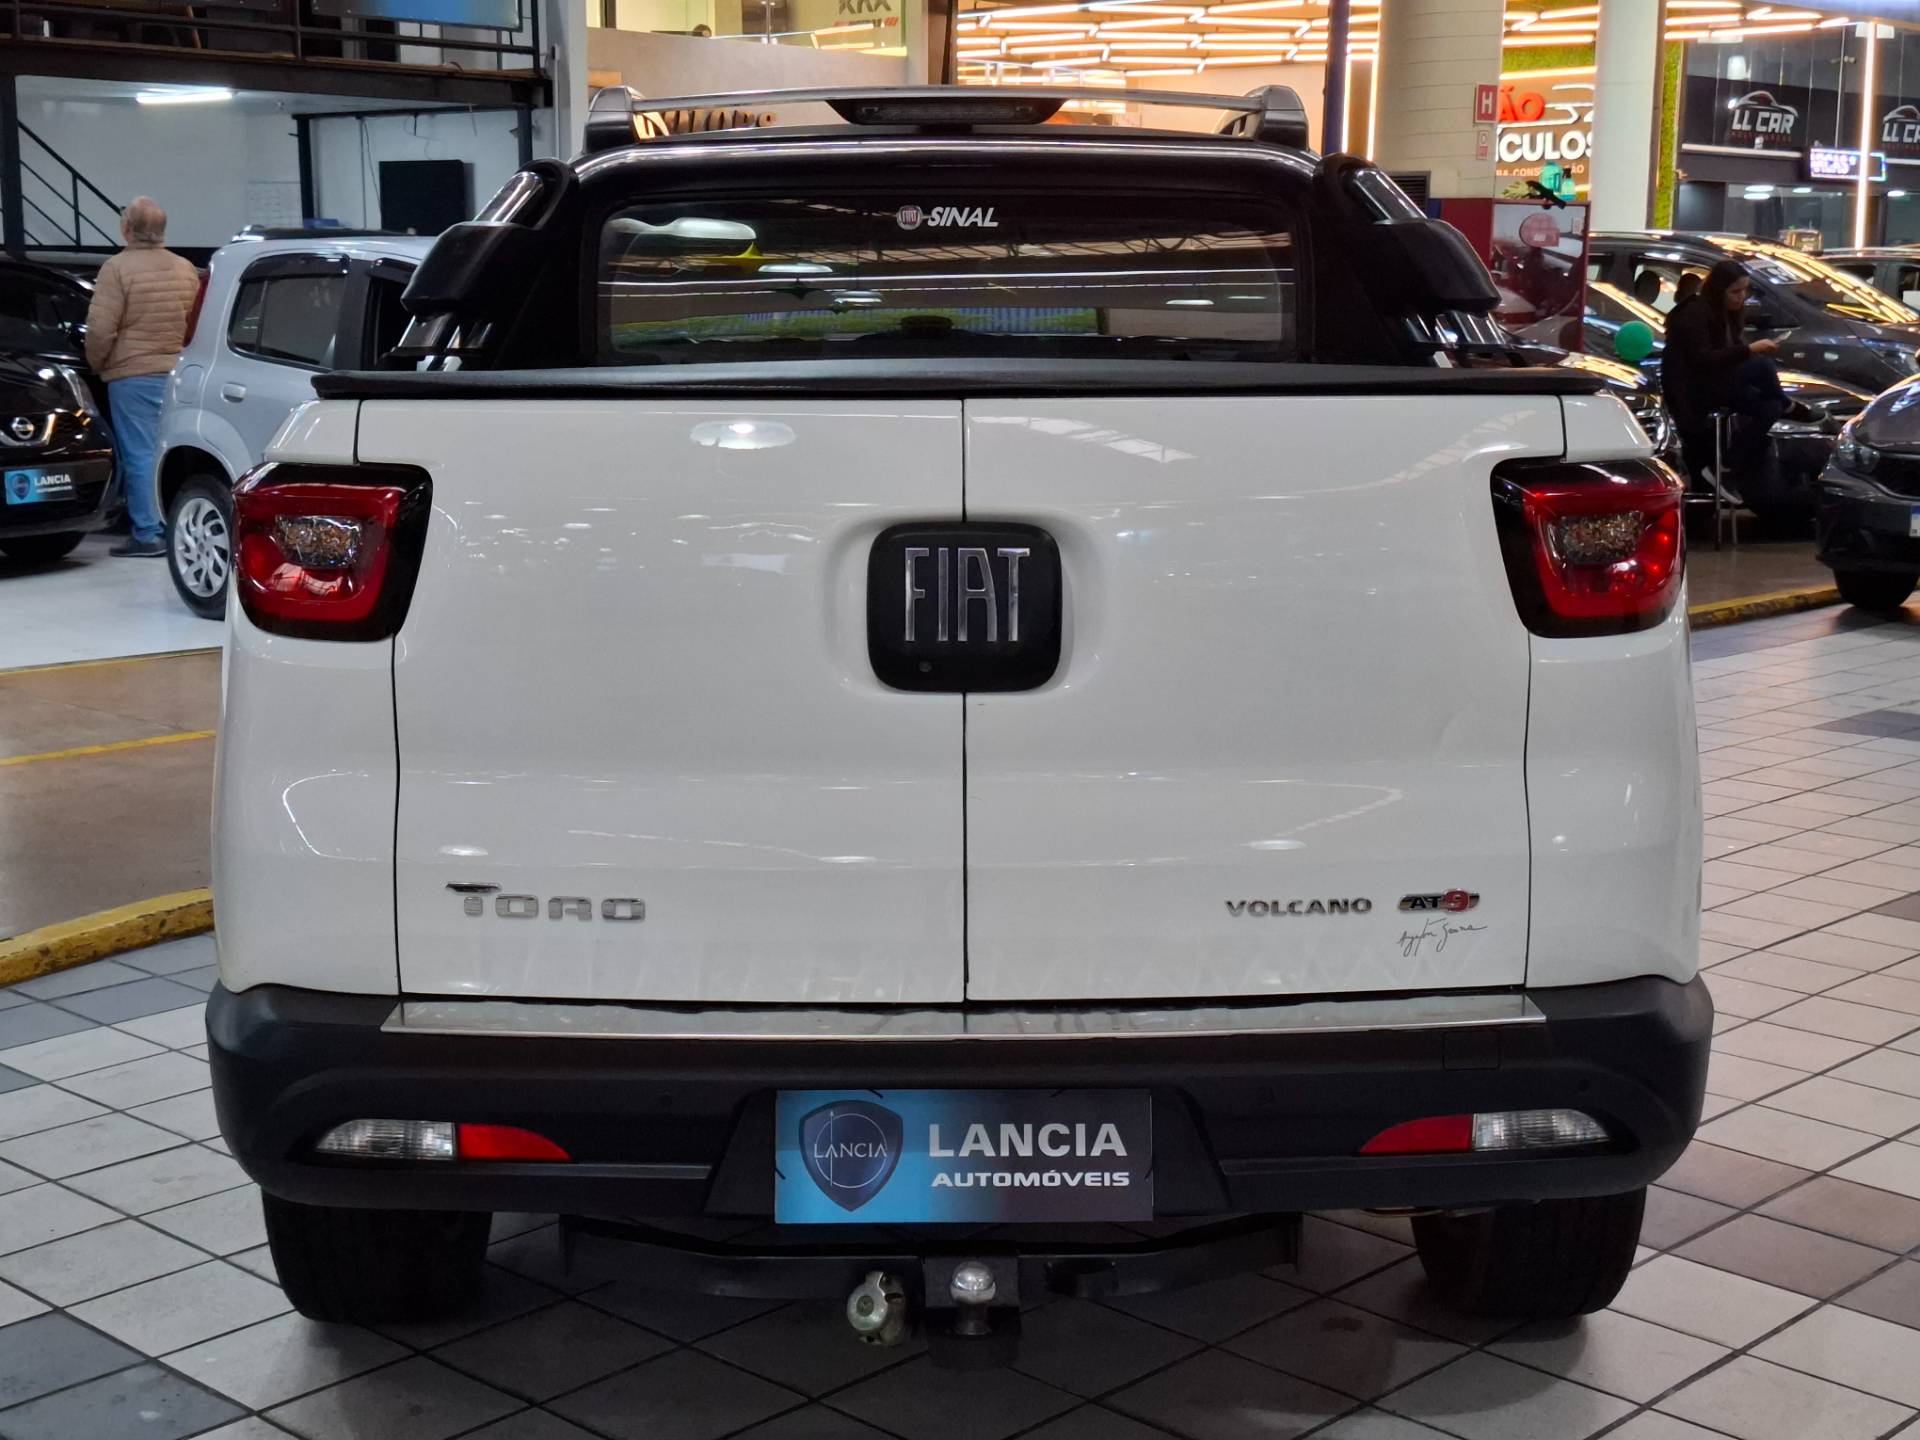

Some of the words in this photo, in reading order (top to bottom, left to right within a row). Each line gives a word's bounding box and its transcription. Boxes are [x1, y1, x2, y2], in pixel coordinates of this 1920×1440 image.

[1732, 109, 1752, 130] LL
[1755, 111, 1794, 134] CAR
[1882, 123, 1899, 142] LL
[927, 206, 999, 227] SINAL
[34, 474, 71, 486] LANCIA
[905, 547, 1030, 642] FIAT
[445, 882, 645, 920] TORO
[1225, 898, 1372, 918] VOLCANO
[1409, 889, 1469, 912] AT9
[813, 1142, 887, 1158] LANCIA
[929, 1122, 1128, 1157] LANCIA
[931, 1169, 1130, 1188] AUTOMÓVEIS
